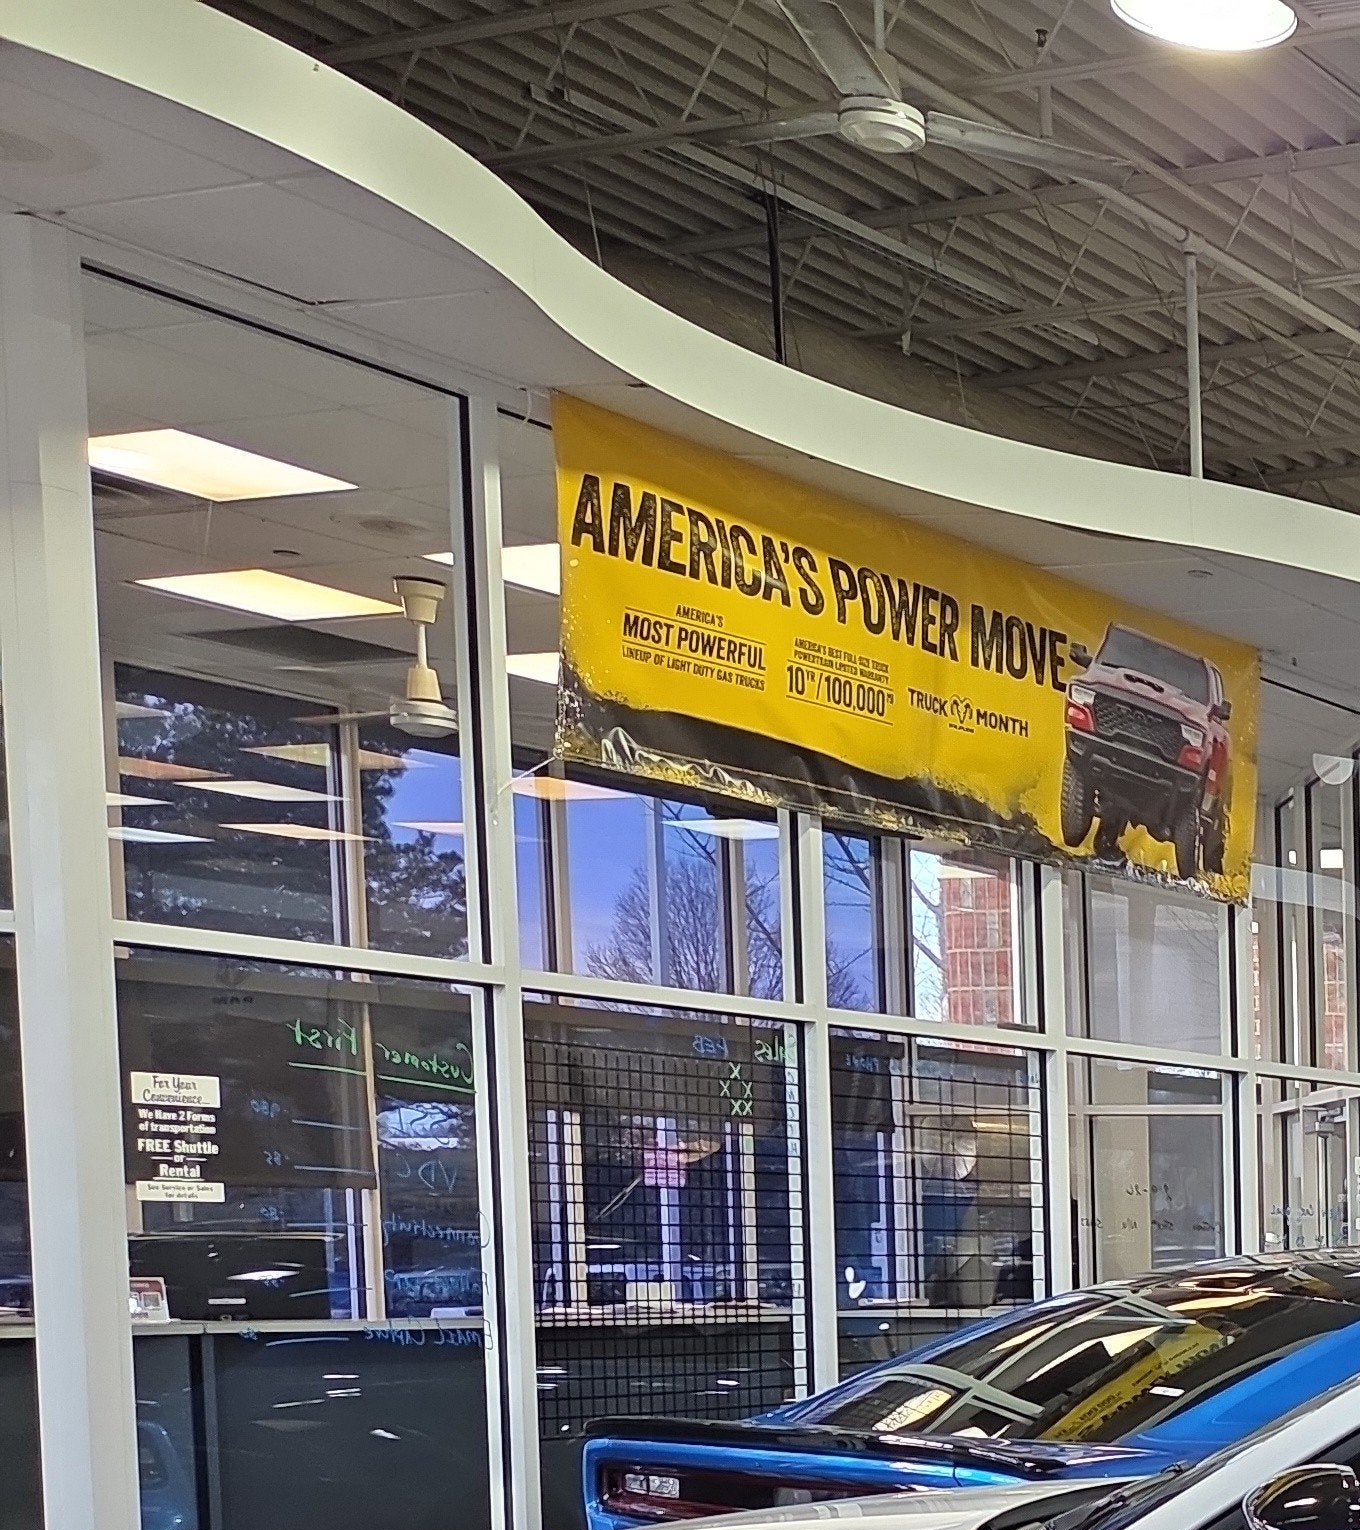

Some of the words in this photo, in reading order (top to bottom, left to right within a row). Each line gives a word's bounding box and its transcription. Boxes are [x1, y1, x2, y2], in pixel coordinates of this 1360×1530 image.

[571, 473, 825, 616] AMERICA'S
[828, 556, 960, 662] POWER
[970, 603, 1068, 692] MOVE
[676, 604, 724, 628] AMERICA'S
[623, 612, 674, 647] MOST
[677, 627, 767, 672] POWERFUL
[622, 645, 652, 664] LINEUP
[653, 653, 665, 667] OF
[667, 655, 692, 673] LIGHT
[693, 663, 716, 679] DUTY
[717, 668, 733, 684] GAS
[735, 673, 766, 692] TRUCKS
[907, 686, 949, 718] TRUCK
[976, 708, 1029, 738] MONTH
[152, 1075, 170, 1089] For
[172, 1076, 198, 1093] Your
[138, 1108, 154, 1120] We
[154, 1109, 178, 1121] Have
[178, 1110, 186, 1121] 2
[186, 1111, 216, 1123] Forms
[138, 1121, 149, 1131] of
[150, 1121, 217, 1135] transportation
[137, 1138, 172, 1152] FREE
[173, 1139, 220, 1155] Shuttle
[173, 1154, 185, 1163] or
[159, 1163, 201, 1178] Rental
